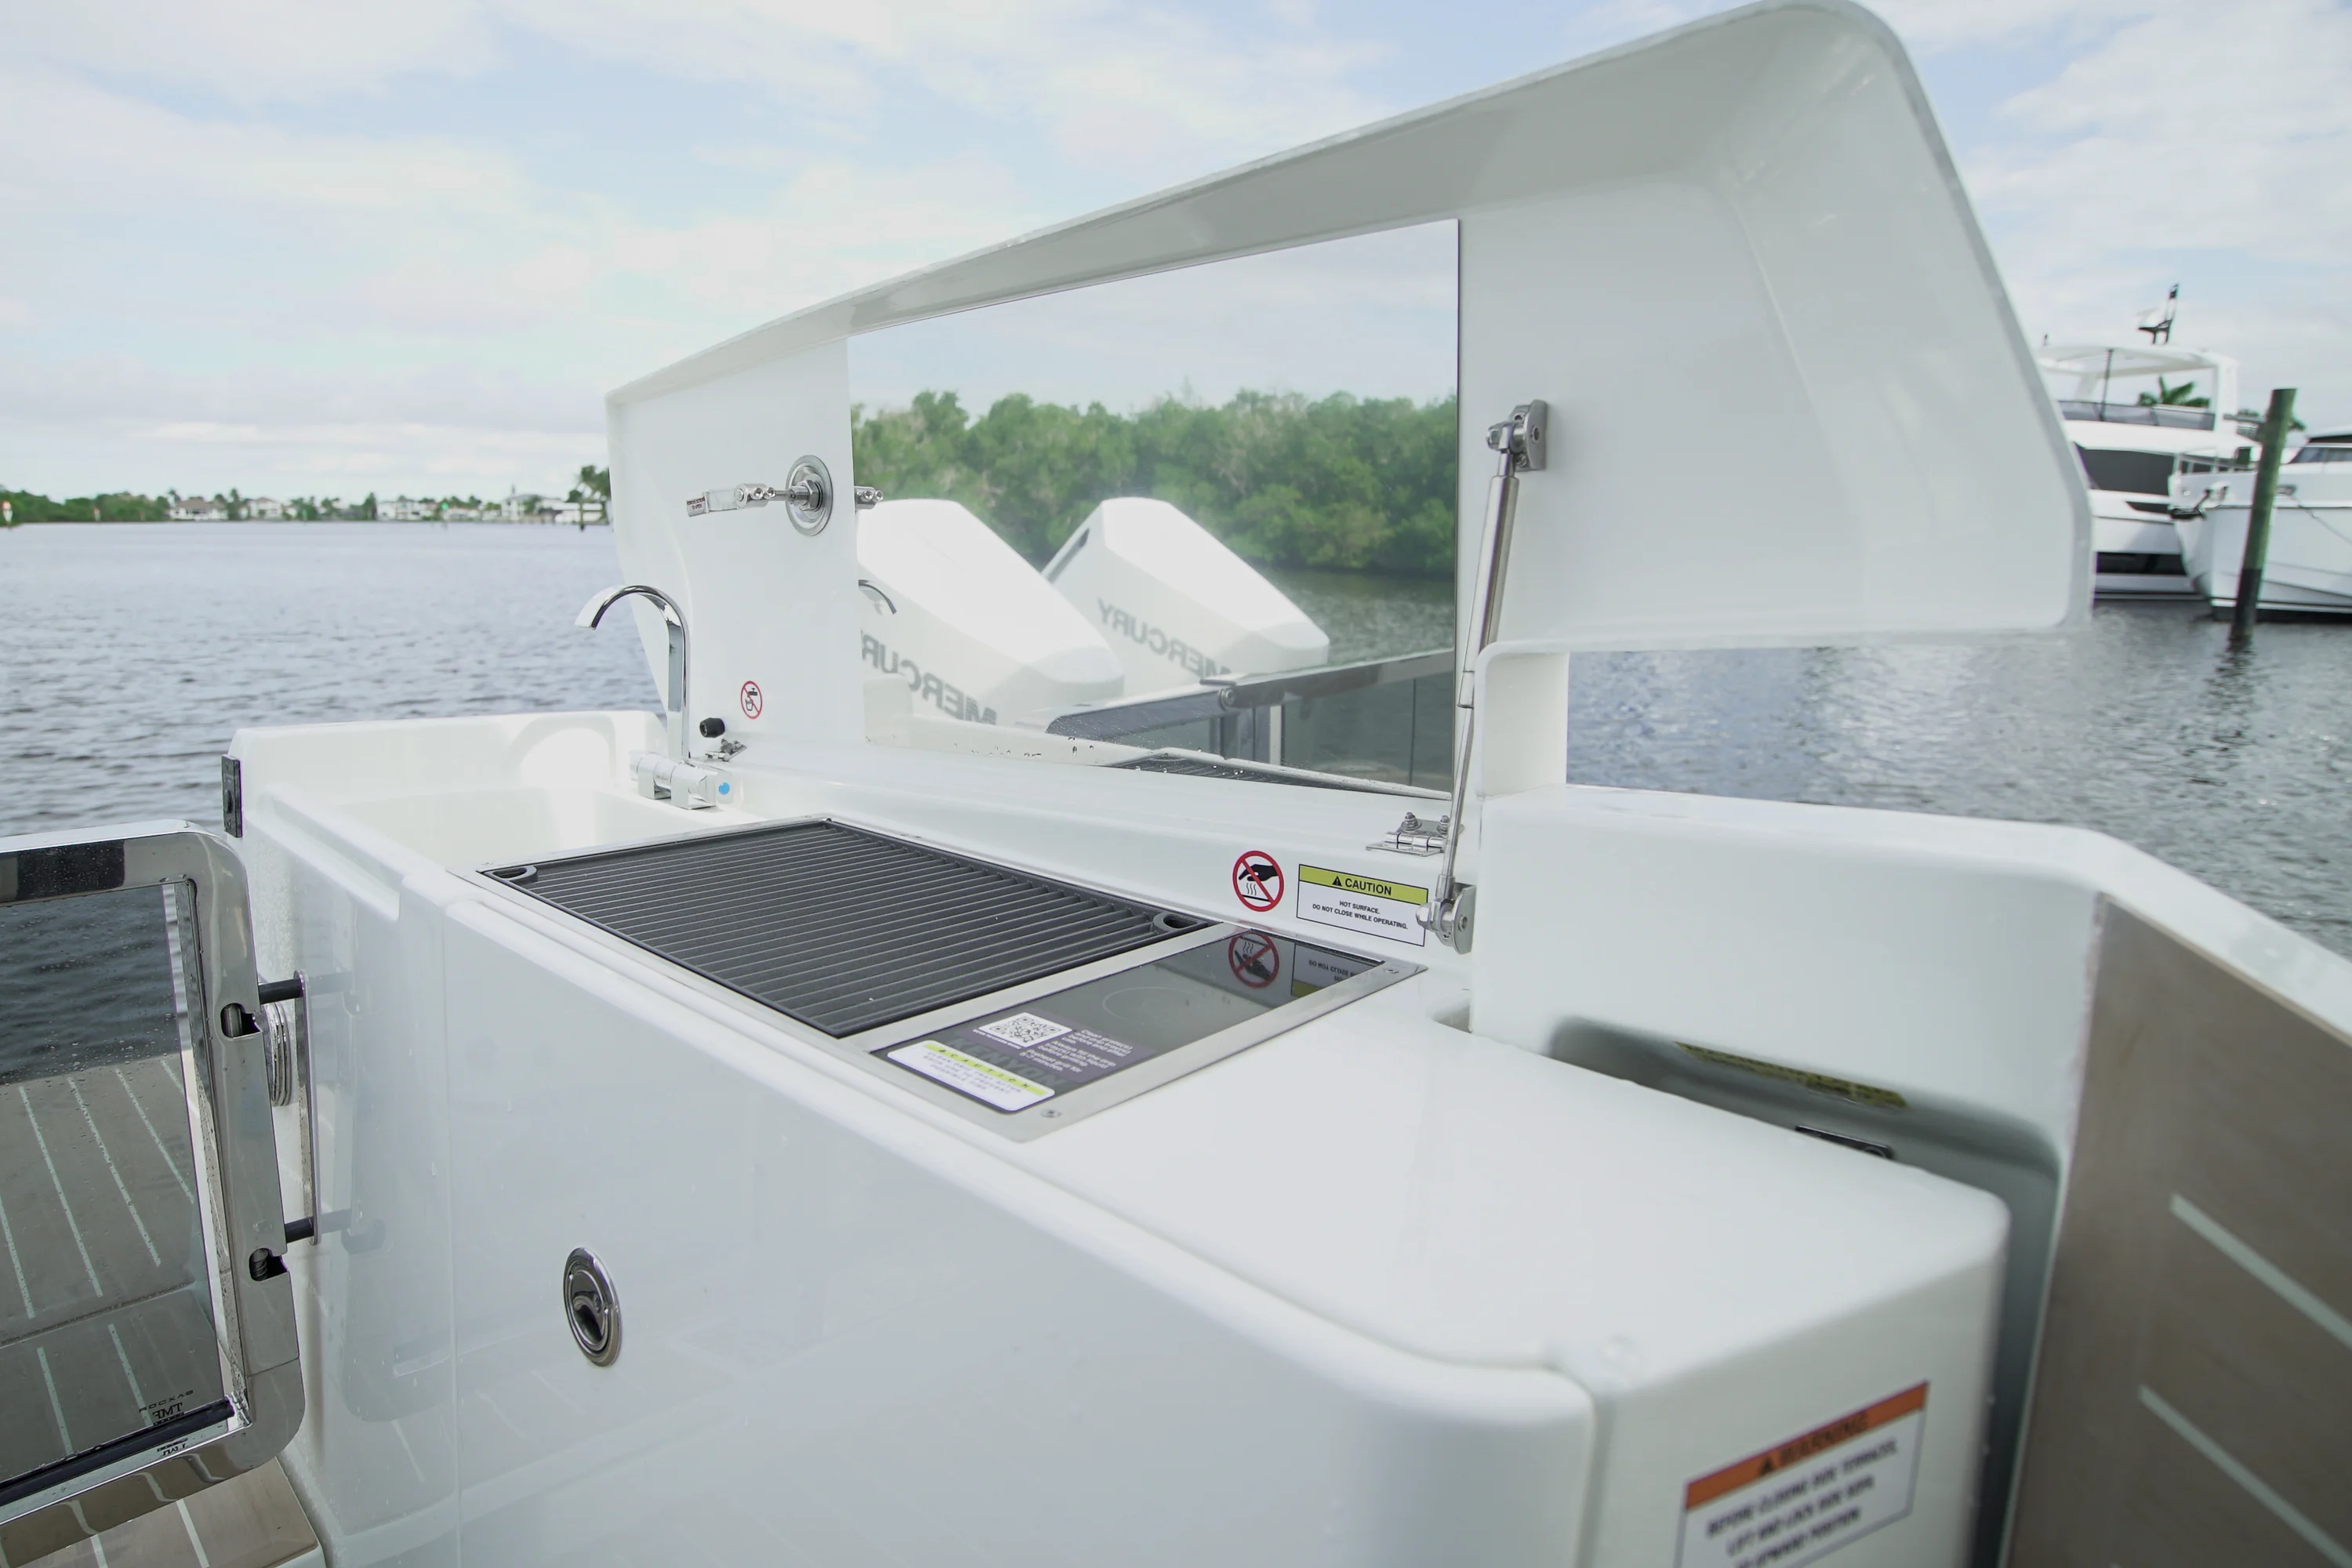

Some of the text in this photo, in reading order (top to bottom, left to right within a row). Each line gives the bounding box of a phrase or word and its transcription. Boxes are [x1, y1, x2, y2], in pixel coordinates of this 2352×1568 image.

[1345, 878, 1392, 895] CAUTION
[1352, 903, 1380, 914] SURFACE.
[1334, 908, 1352, 917] CLOSE
[1354, 913, 1372, 922] WHILE
[1373, 916, 1408, 929] OPERATING.
[947, 1038, 1067, 1088] KENYON
